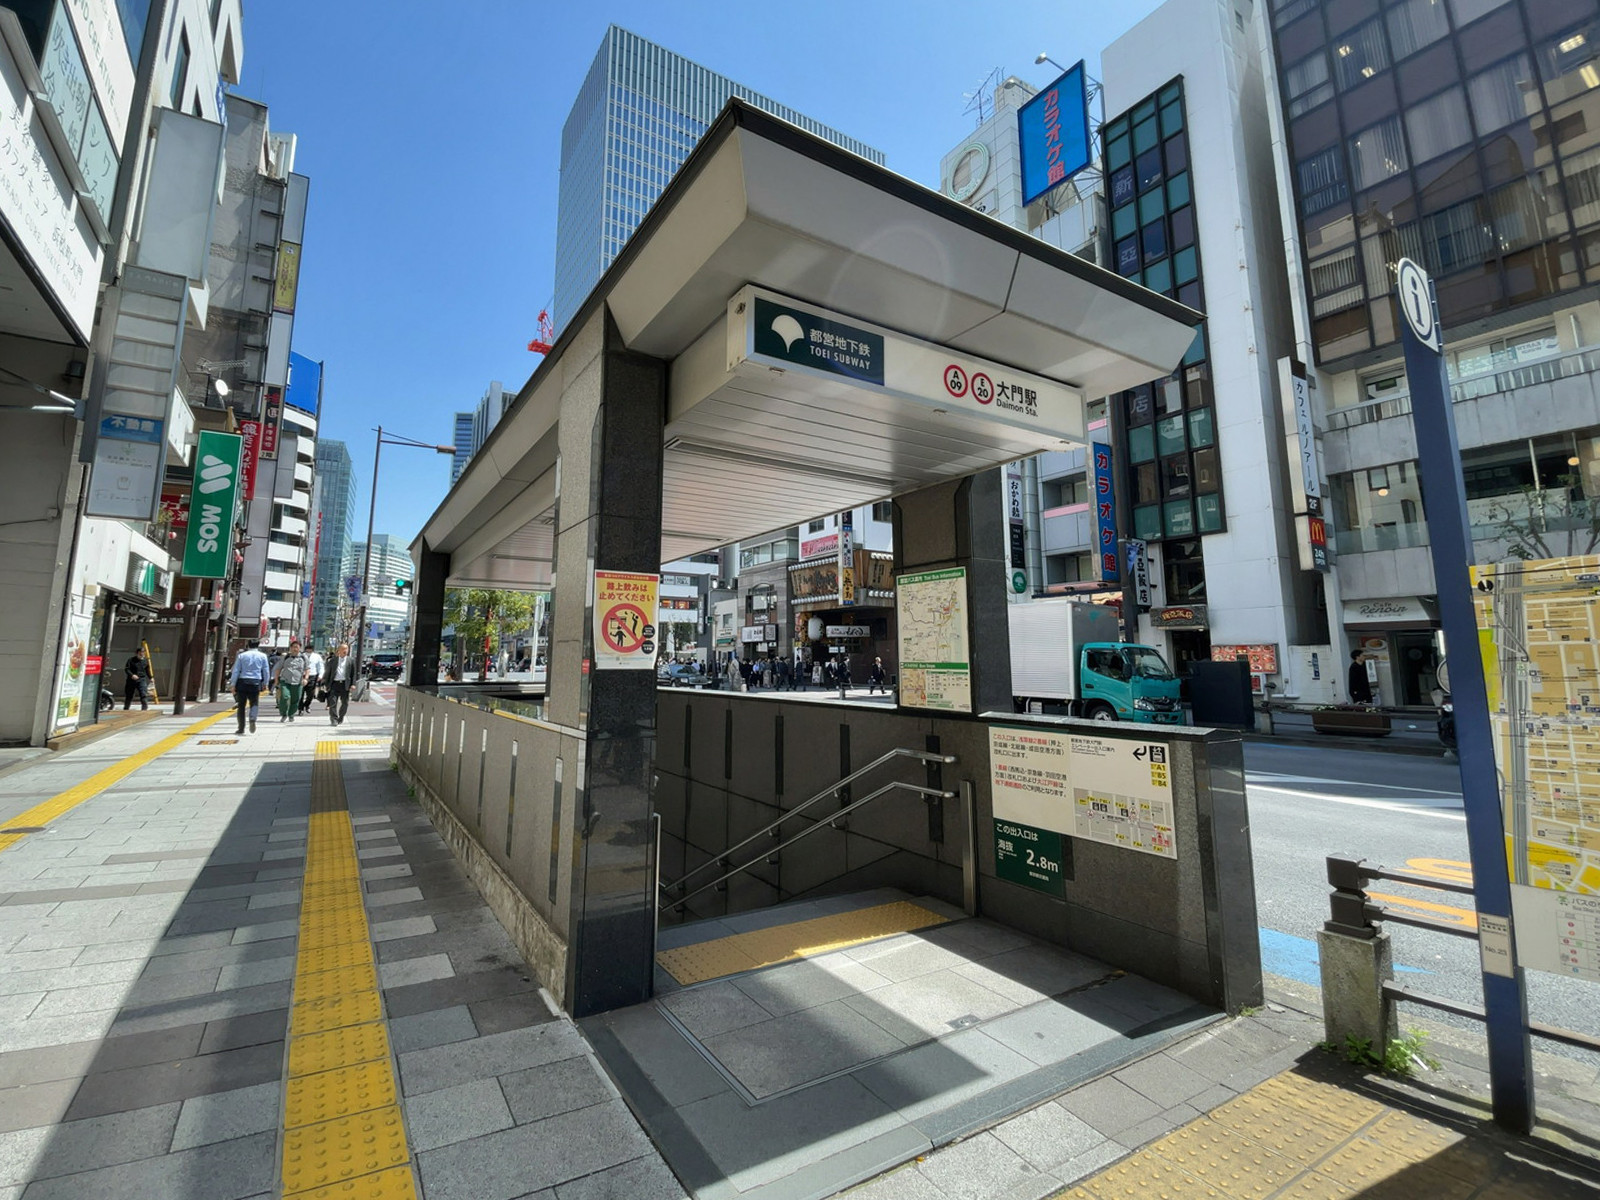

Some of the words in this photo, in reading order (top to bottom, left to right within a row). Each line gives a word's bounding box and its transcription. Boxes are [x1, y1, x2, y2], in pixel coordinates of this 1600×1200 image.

[1043, 87, 1066, 184] カラオケ館
[809, 327, 872, 358] 都営地下鉄
[810, 345, 831, 360] TOEI
[832, 350, 871, 371] SUBWAY
[952, 370, 960, 380] A
[979, 377, 986, 387] E
[949, 379, 963, 392] 09
[976, 386, 990, 399] 20
[996, 380, 1038, 408] 大門駅
[995, 399, 1025, 414] Daimon
[1024, 407, 1039, 417] Sta.
[1096, 452, 1117, 573] カラオケ館
[197, 504, 222, 554] MOS
[599, 591, 654, 602] 止めてください
[996, 823, 1039, 842] この出入口は
[997, 838, 1014, 853] 海抜
[1025, 849, 1059, 874] 2.8m
